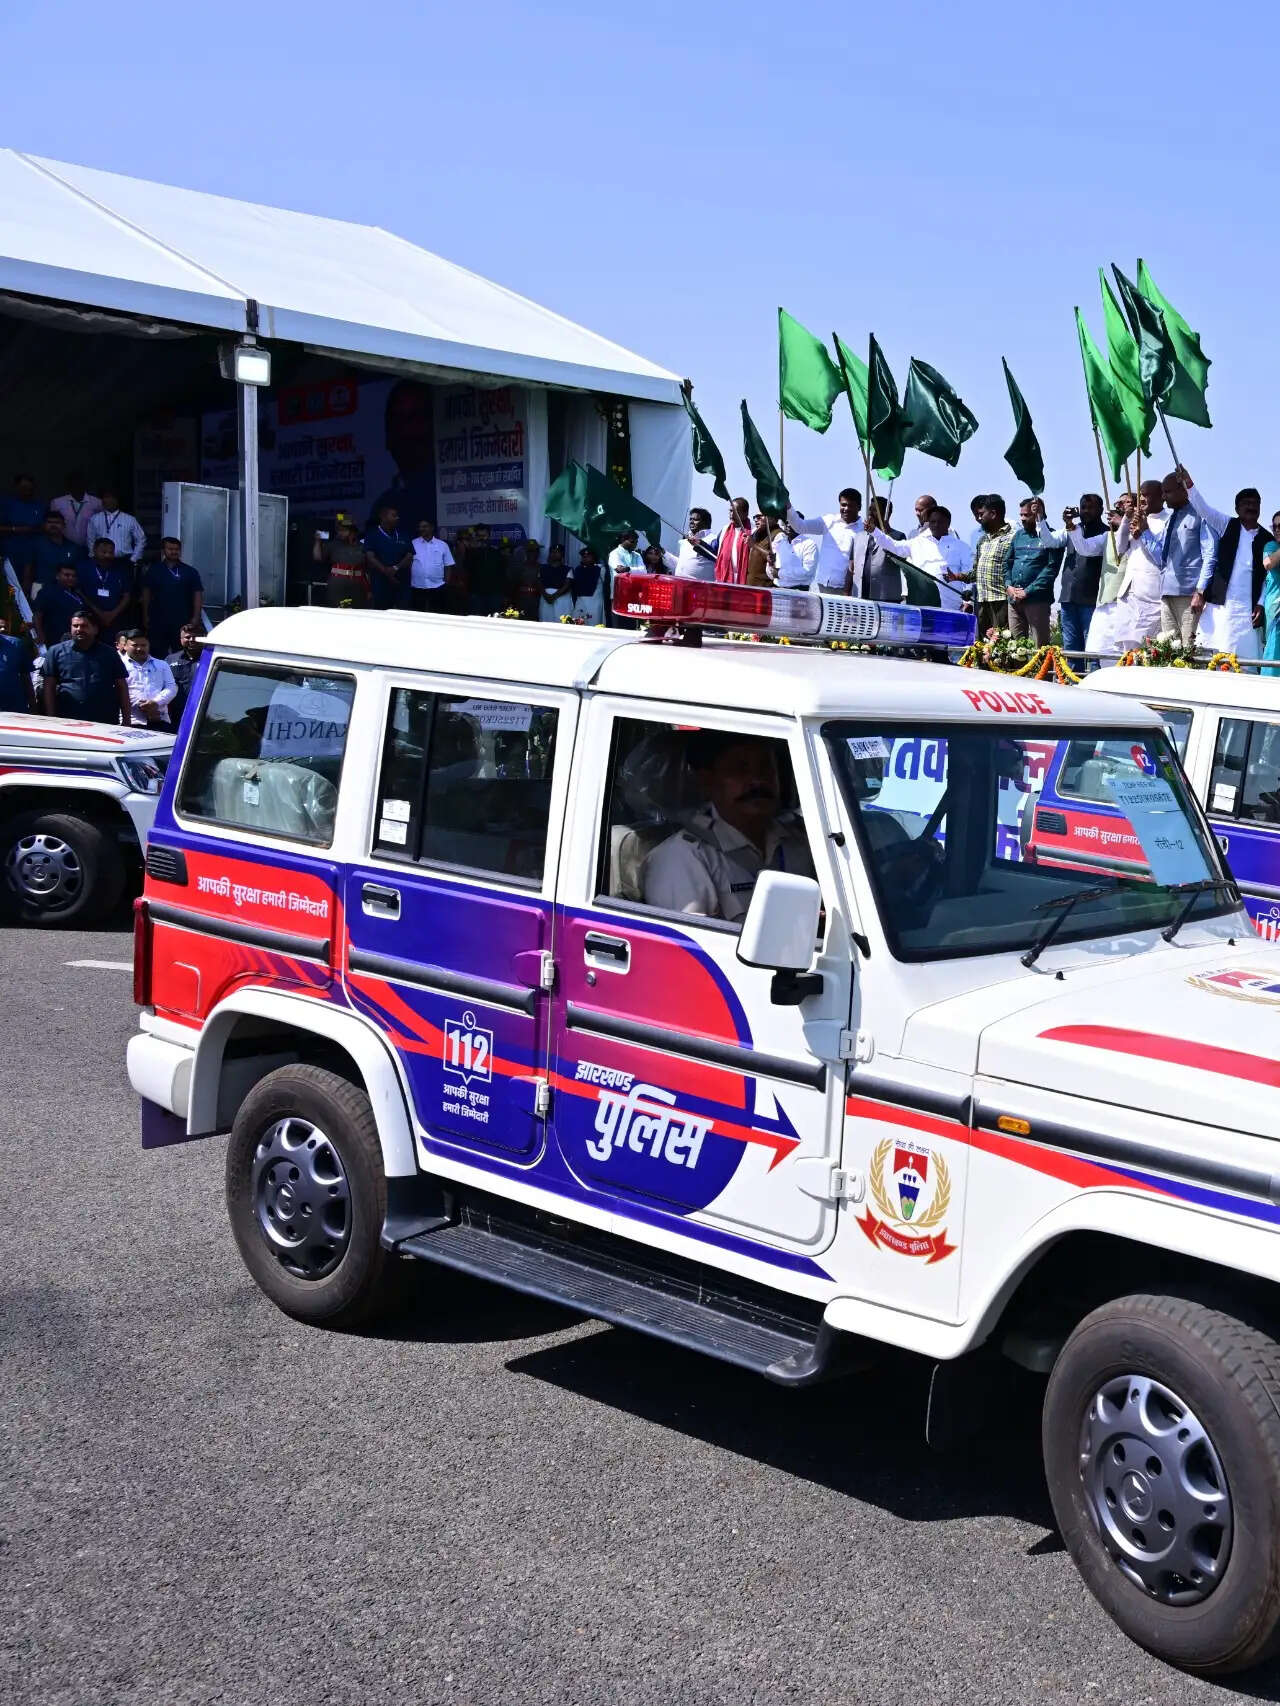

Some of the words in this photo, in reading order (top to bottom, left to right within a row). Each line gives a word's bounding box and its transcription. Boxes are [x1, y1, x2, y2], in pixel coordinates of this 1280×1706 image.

[961, 689, 1053, 715] POLICE
[1073, 826, 1099, 841] आपकी
[1100, 830, 1122, 845] सुरक्षा
[1122, 834, 1141, 846] हमार
[197, 876, 231, 897] आपकी
[232, 884, 261, 906] सुरक्षा
[261, 891, 286, 909] हमारी
[288, 893, 329, 918] जिम्मेदारी
[448, 1028, 489, 1075] 112
[575, 1060, 635, 1091] झारखण्ड
[443, 1083, 468, 1100] आपकी
[468, 1091, 490, 1107] सुरक्षा
[442, 1101, 460, 1116] हमारी
[461, 1105, 489, 1124] जिम्मेदारी
[585, 1083, 715, 1170] पुलिस
